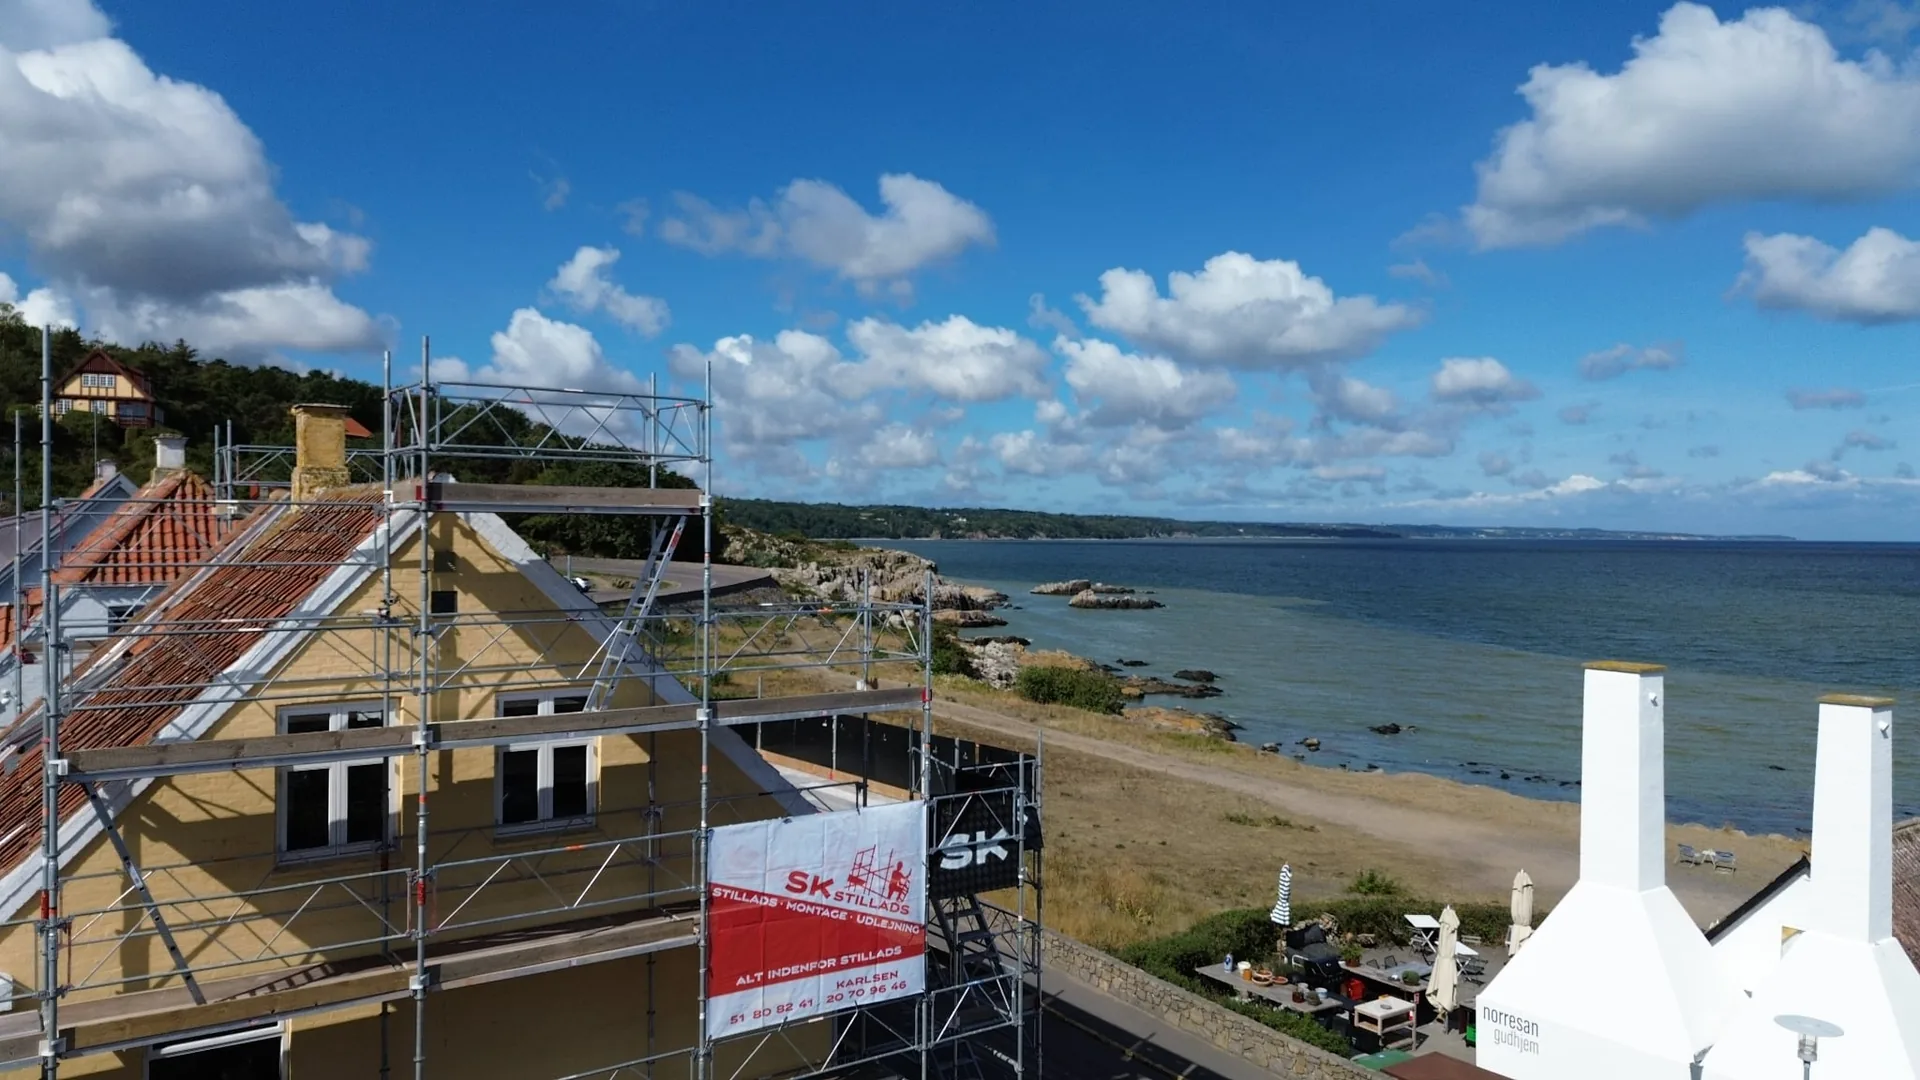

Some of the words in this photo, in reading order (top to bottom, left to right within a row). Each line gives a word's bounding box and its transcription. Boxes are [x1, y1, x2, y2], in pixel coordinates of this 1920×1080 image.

[939, 828, 1008, 870] SK
[711, 887, 778, 907] STILLADS
[786, 901, 848, 920] MONTAGE
[856, 914, 920, 934] UDLEJNING
[784, 870, 834, 899] SK
[834, 891, 910, 915] STILLADS
[735, 972, 763, 986] ALT
[767, 958, 837, 979] INDENFOR
[840, 945, 902, 965] STILLADS
[836, 970, 899, 990] KARLSEN
[730, 1013, 745, 1025] 51
[752, 1008, 772, 1019] 80
[776, 1002, 793, 1014] 82
[799, 998, 813, 1009] 41
[826, 992, 844, 1004] 20
[848, 988, 865, 999] 70
[870, 984, 887, 995] 96
[891, 980, 907, 990] 46
[1483, 1005, 1539, 1037] norresan
[1494, 1028, 1540, 1055] gudhjem
